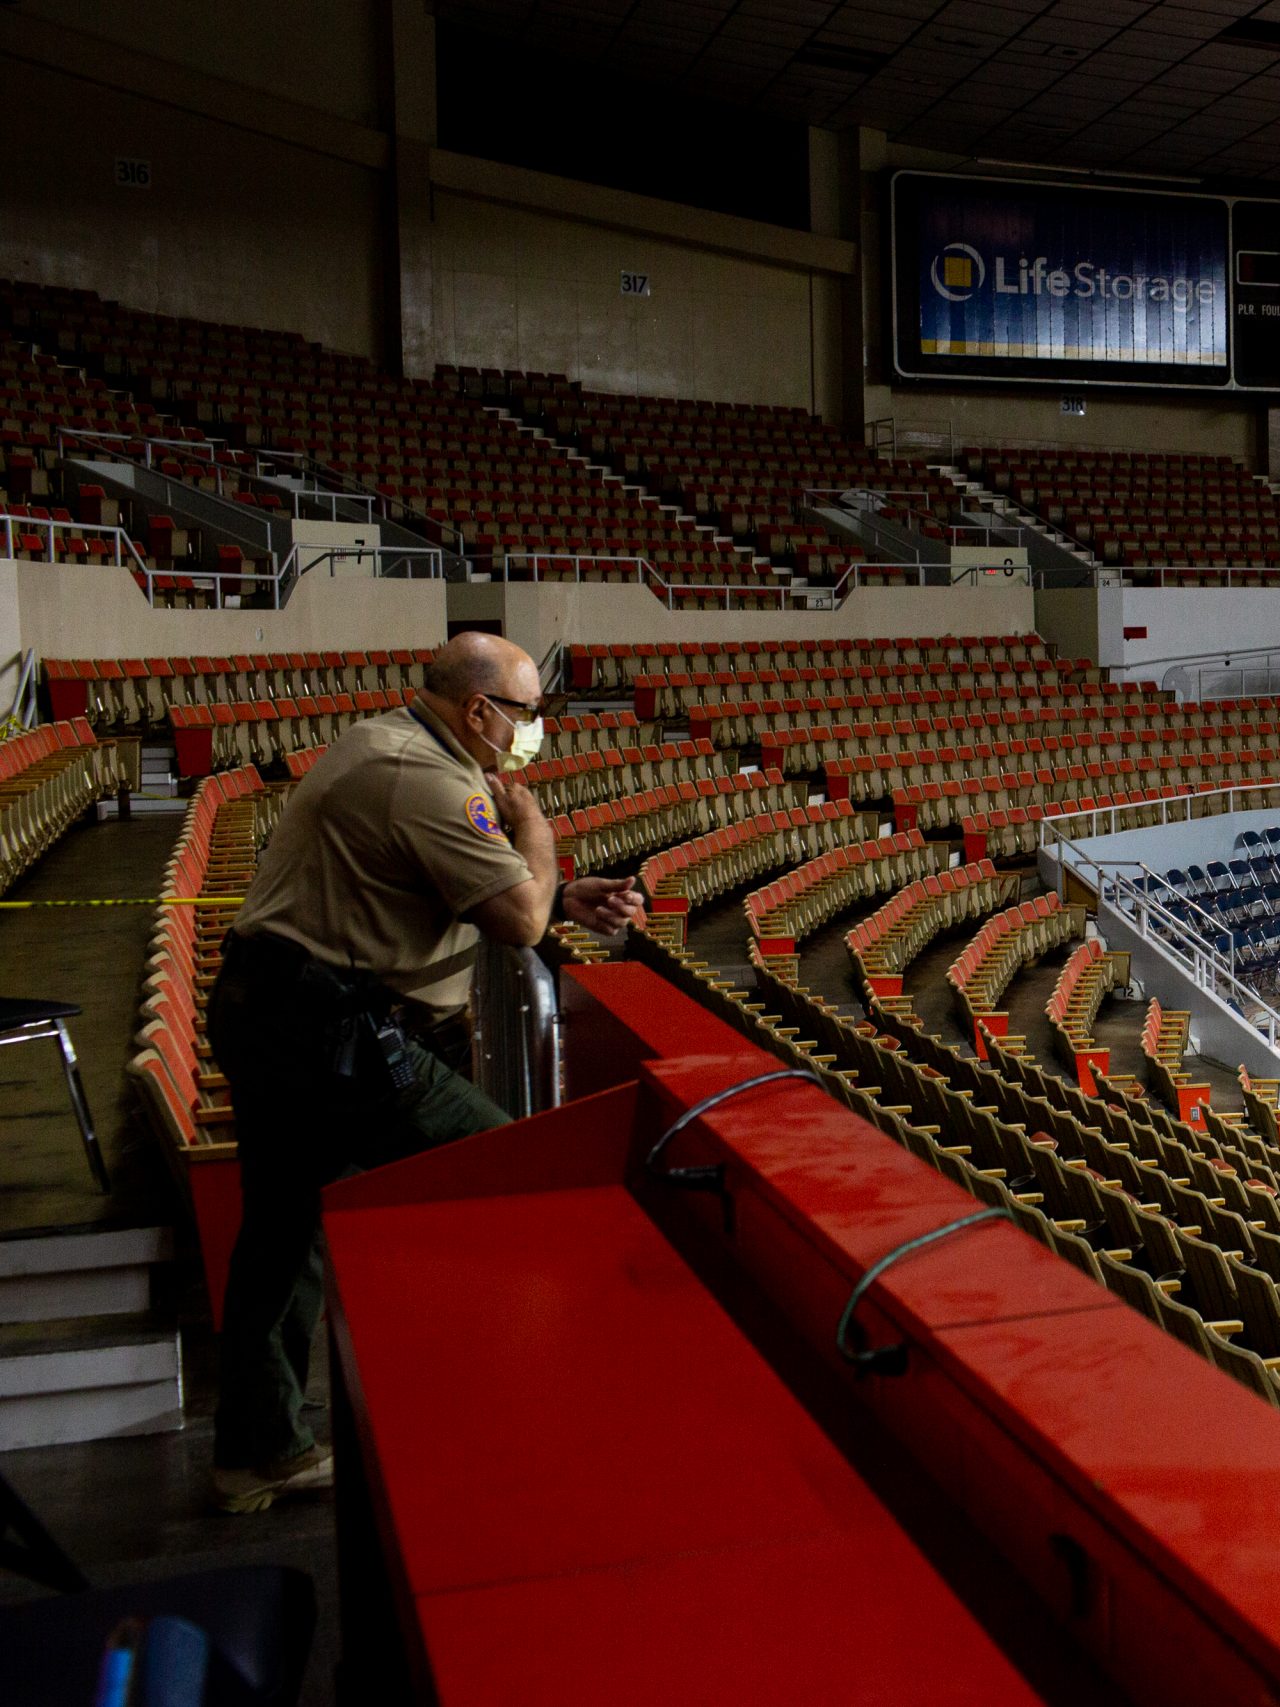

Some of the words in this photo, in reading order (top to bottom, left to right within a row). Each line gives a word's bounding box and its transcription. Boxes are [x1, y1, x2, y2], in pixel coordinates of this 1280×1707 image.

[117, 160, 149, 185] 316
[622, 274, 648, 294] 317
[997, 255, 1071, 297] Life
[1073, 262, 1216, 313] Storage
